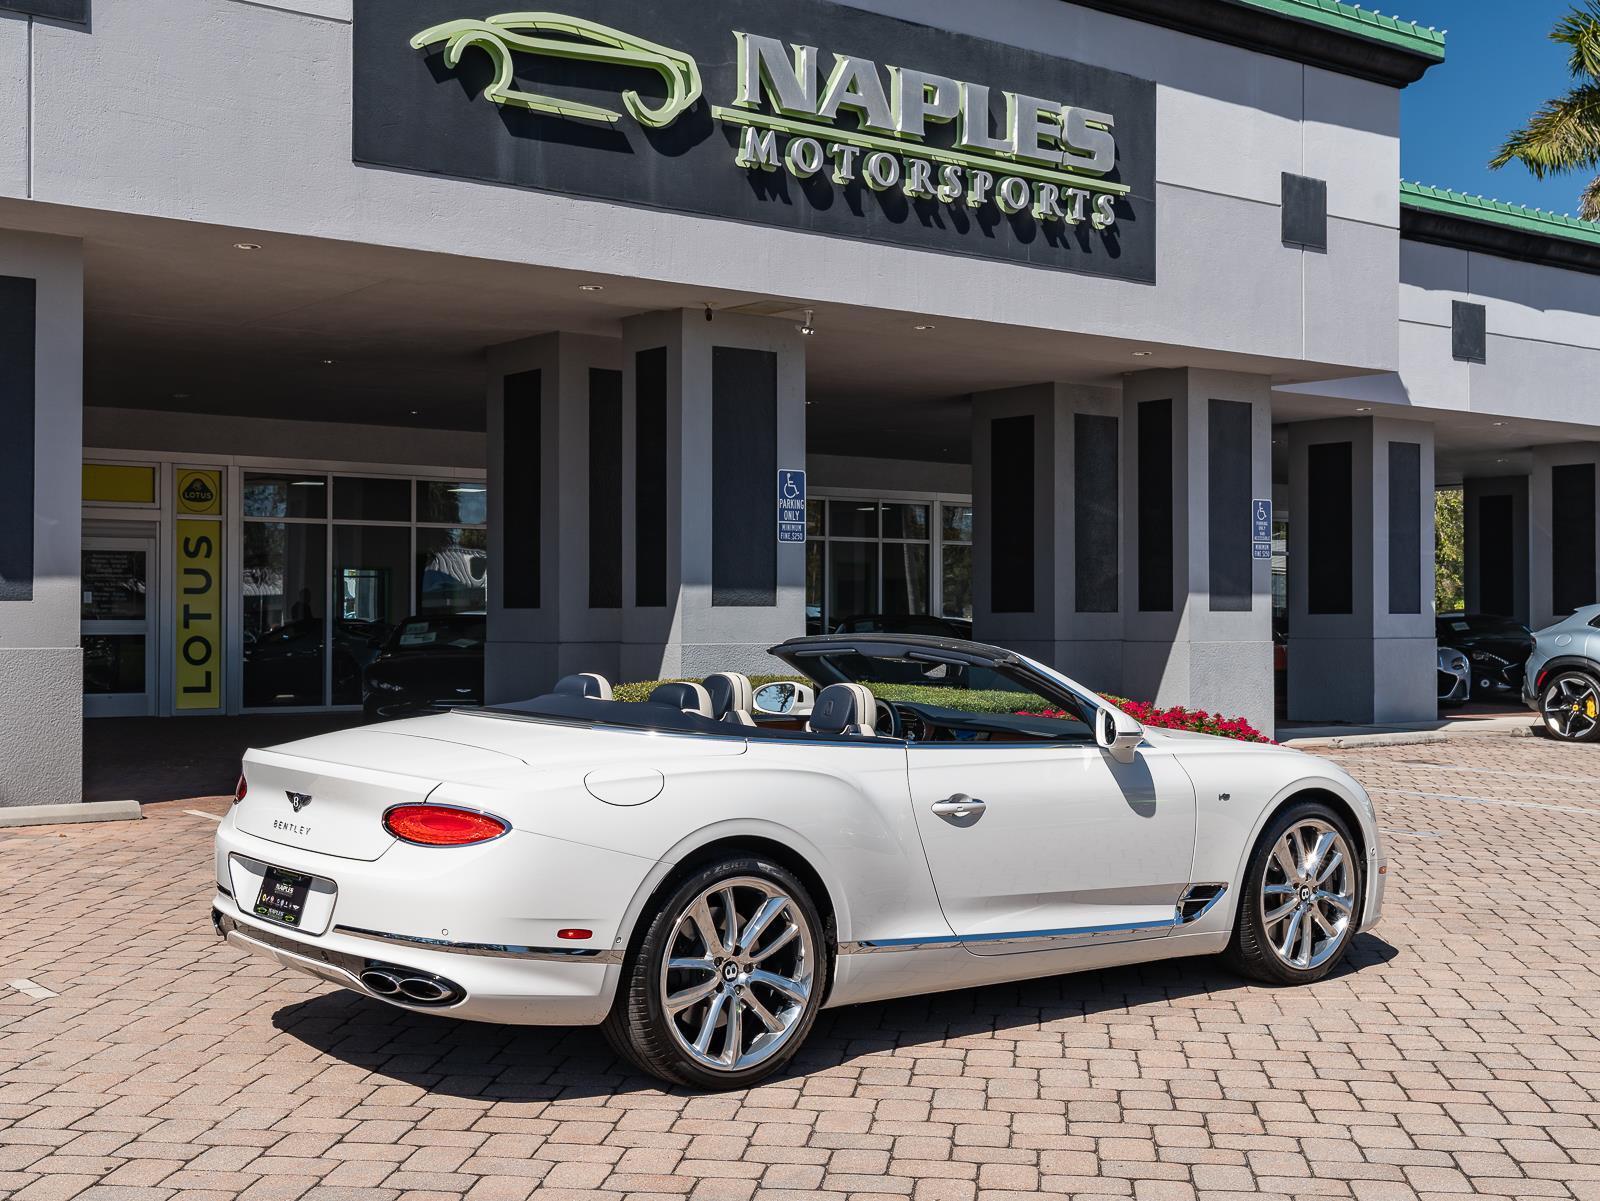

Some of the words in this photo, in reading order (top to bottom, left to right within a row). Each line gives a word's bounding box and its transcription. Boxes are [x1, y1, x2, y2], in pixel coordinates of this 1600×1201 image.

[732, 30, 1116, 175] NAPLES
[736, 126, 1116, 229] MOTORSPORTS
[184, 491, 212, 500] LOTUS
[779, 498, 805, 510] PARKING
[783, 510, 800, 521] ONLY
[781, 524, 802, 532] MINIMUM
[780, 532, 791, 540] FINE
[182, 535, 213, 694] LOTUS
[273, 819, 311, 835] BENTLEY
